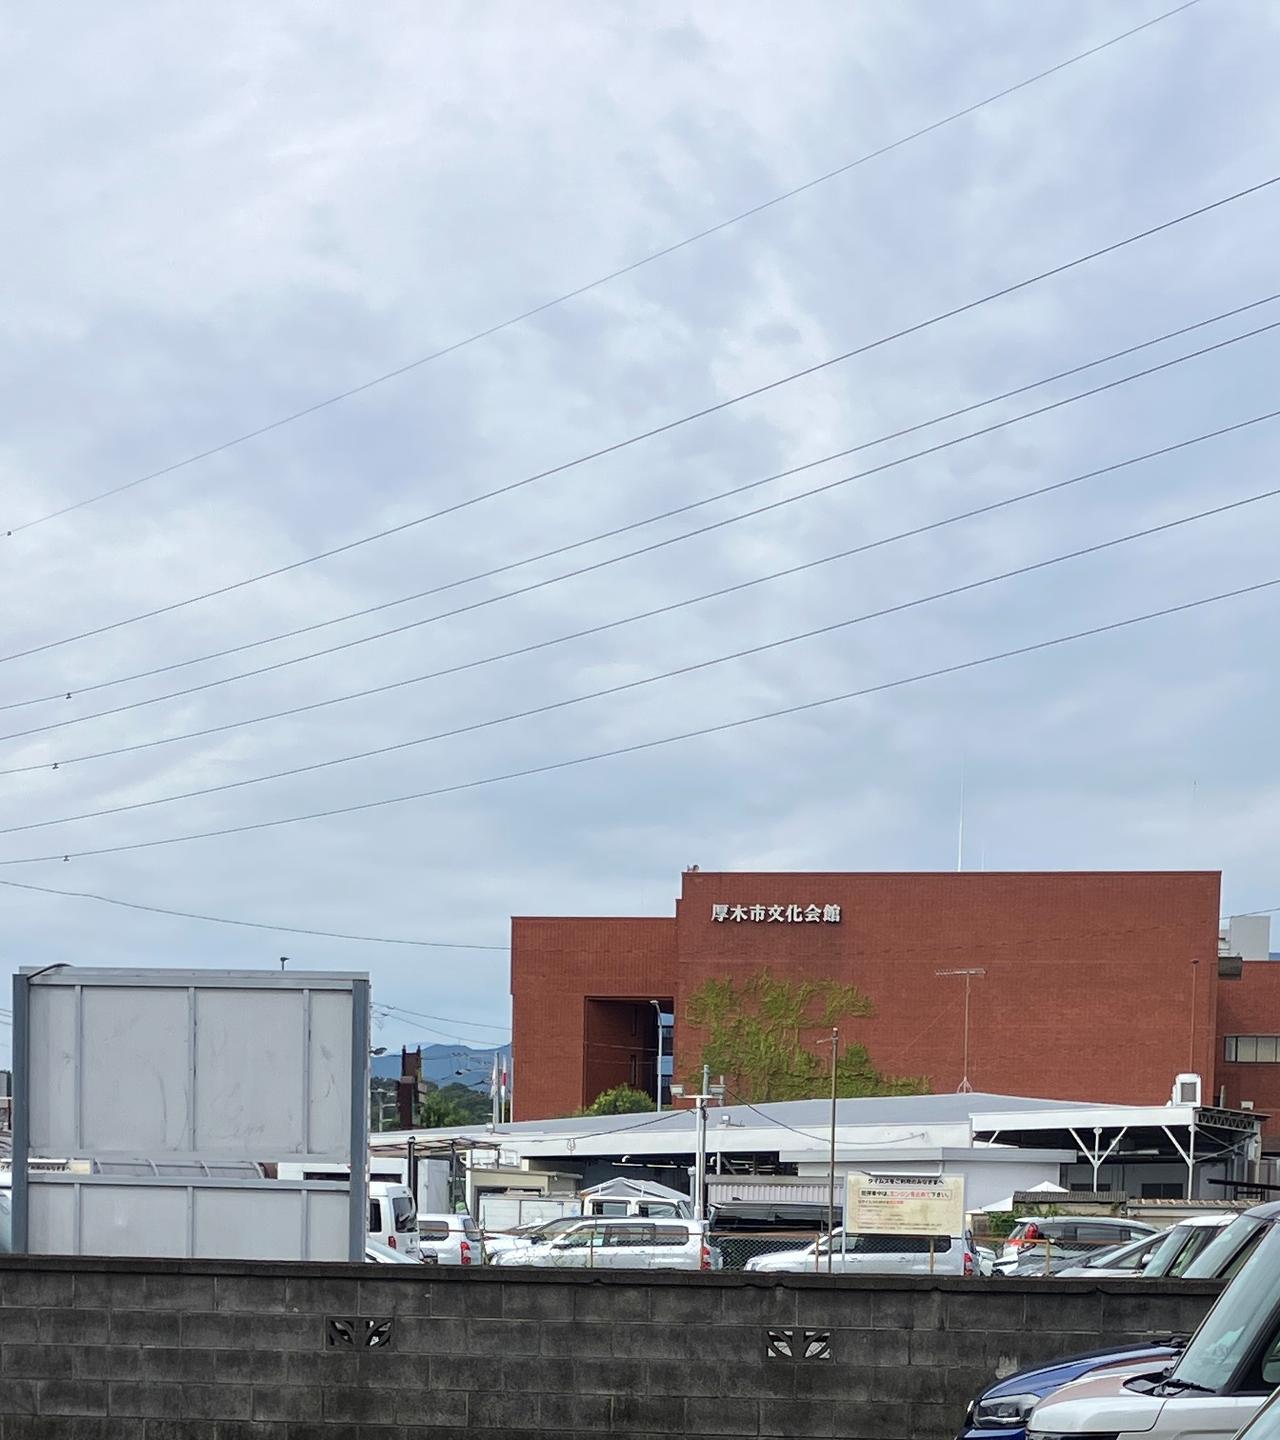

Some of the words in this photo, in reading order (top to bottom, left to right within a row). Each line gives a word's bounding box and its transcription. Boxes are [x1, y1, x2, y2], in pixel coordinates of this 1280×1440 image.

[711, 903, 841, 923] 厚木市文化会館
